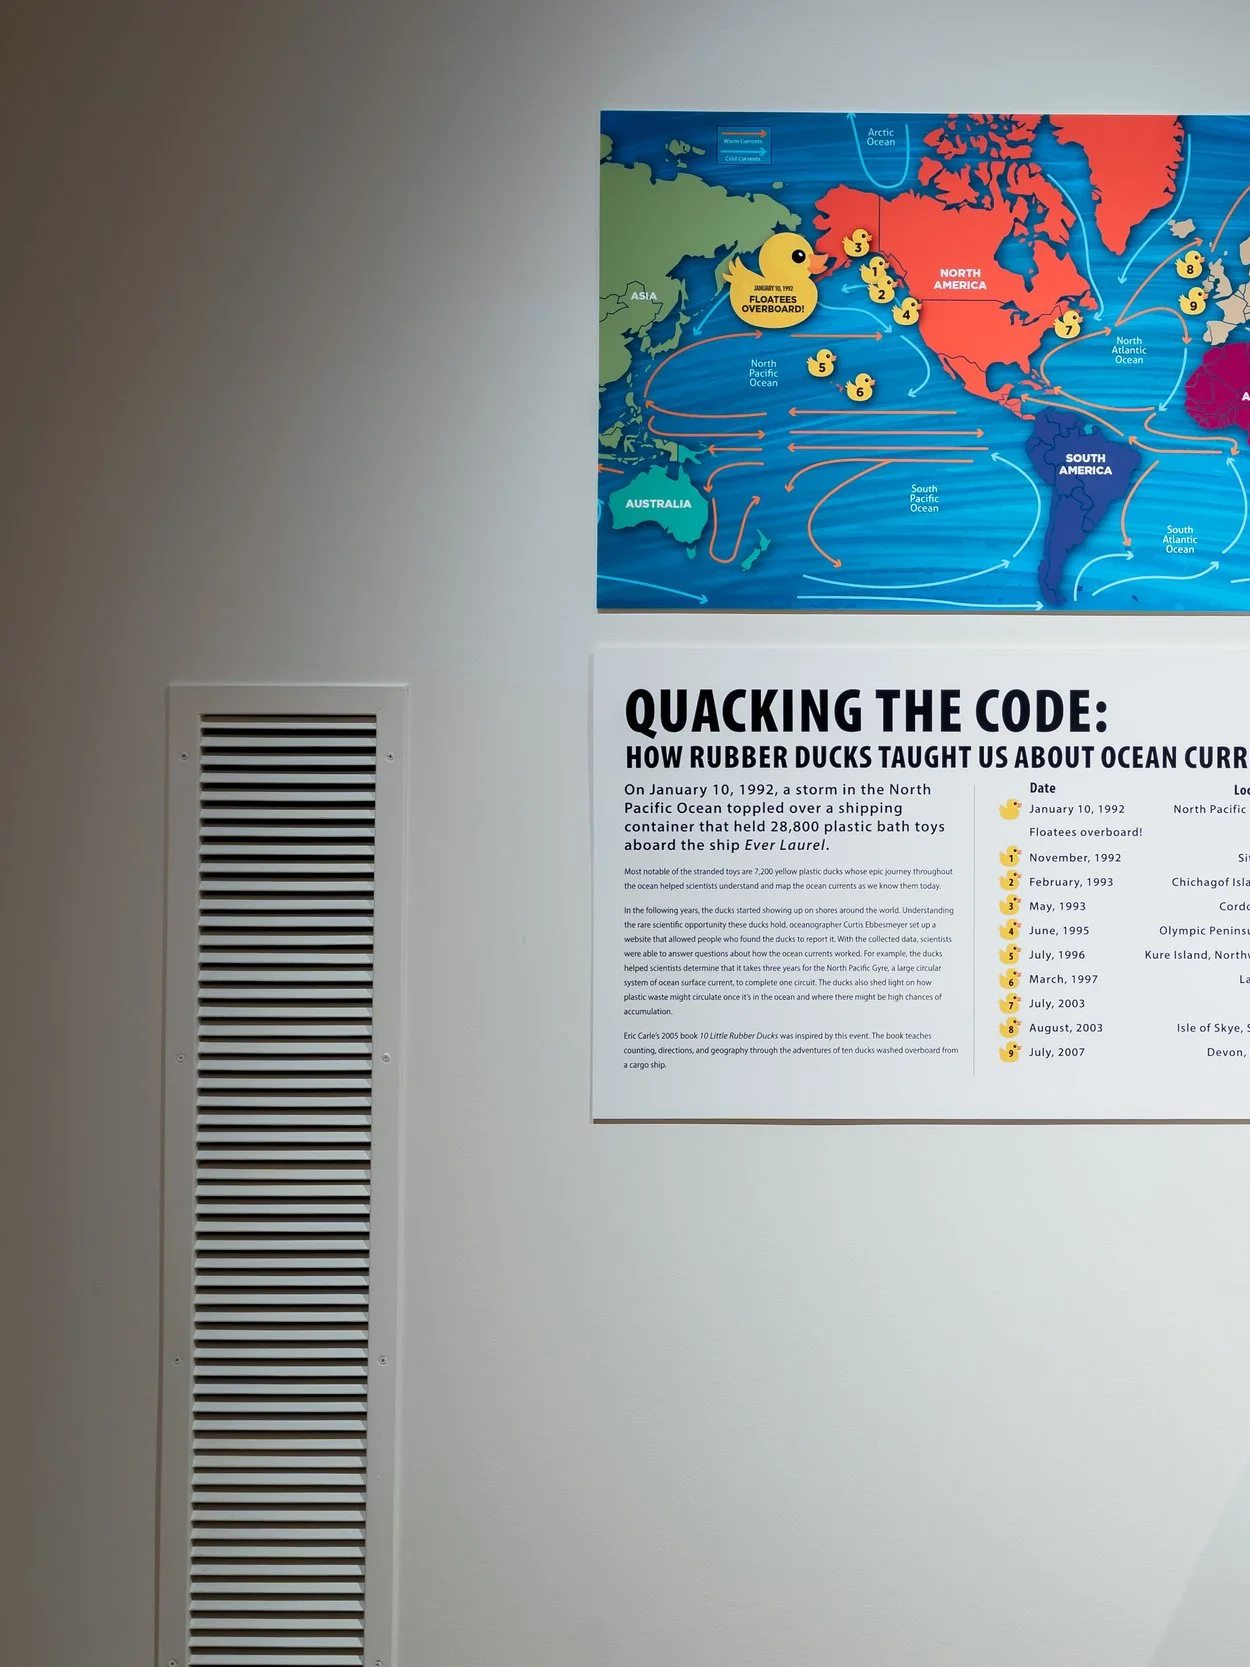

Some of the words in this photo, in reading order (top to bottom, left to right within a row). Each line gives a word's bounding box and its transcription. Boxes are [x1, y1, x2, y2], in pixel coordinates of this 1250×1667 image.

[868, 128, 894, 137] Arctic
[866, 137, 895, 147] Ocean
[854, 243, 862, 253] 3
[872, 266, 877, 277] 1
[940, 268, 981, 278] NORTH
[1186, 264, 1194, 274] 8
[934, 280, 987, 290] AMERICA
[631, 291, 658, 300] ASIA
[749, 295, 797, 304] FLOATEES
[878, 289, 886, 300] 2
[741, 304, 804, 313] OVERBOARD!
[1190, 301, 1198, 311] 9
[902, 310, 911, 320] 4
[1065, 325, 1073, 336] 7
[1116, 336, 1142, 345] North
[1112, 346, 1147, 355] Atlantic
[751, 359, 777, 368] North
[1114, 355, 1144, 364] Ocean
[818, 362, 826, 372] 5
[749, 369, 778, 378] Pacific
[749, 378, 778, 387] Ocean
[856, 387, 864, 397] 6
[1066, 454, 1106, 463] SOUTH
[1059, 466, 1112, 475] AMERICA
[911, 484, 938, 494] South
[626, 499, 692, 508] AUSTRALIA
[910, 494, 938, 503] Pacific
[910, 503, 939, 512] Ocean
[1167, 525, 1194, 534] South
[1162, 535, 1197, 544] Atlantic
[1166, 544, 1194, 554] Ocean
[625, 688, 862, 740] QUACKING
[875, 689, 961, 732] THE
[976, 689, 1107, 733] CODE:
[626, 745, 683, 769] HOW
[690, 745, 788, 768] RUBBER
[795, 745, 872, 768] DUCKS
[878, 745, 972, 768] TAUGHT
[979, 746, 1008, 768] US
[1014, 746, 1094, 768] ABOUT
[1101, 746, 1177, 768] OCEAN
[624, 783, 644, 796] On
[649, 784, 708, 798] January
[713, 784, 734, 797] 10,
[740, 784, 778, 797] 1992,
[783, 786, 790, 795] a
[796, 785, 837, 795] storm
[843, 783, 856, 795] in
[860, 783, 884, 795] the
[890, 783, 931, 795] North
[1030, 782, 1056, 794] Date
[625, 801, 672, 814] Pacific
[677, 802, 722, 814] Ocean
[727, 802, 784, 817] toppled
[789, 805, 821, 814] over
[826, 805, 833, 814] a
[839, 802, 902, 817] shipping
[1029, 804, 1074, 816] January
[1078, 804, 1094, 814] 10,
[1098, 804, 1125, 814] 1992
[1174, 804, 1206, 814] North
[1210, 804, 1246, 814] Pacific
[624, 820, 695, 832] container
[699, 820, 729, 832] that
[734, 820, 765, 832] held
[770, 821, 819, 834] 28,800
[824, 820, 872, 835] plastic
[877, 820, 910, 832] bath
[915, 822, 945, 835] toys
[1029, 827, 1077, 837] Floatees
[1080, 827, 1142, 837] overboard!
[624, 838, 676, 851] aboard
[680, 838, 705, 851] the
[710, 838, 740, 854] ship
[745, 839, 776, 851] Ever
[780, 838, 829, 851] Laurel.
[1009, 854, 1013, 862] 1
[1030, 853, 1090, 863] November,
[1095, 853, 1121, 862] 1992
[624, 868, 642, 876] Most
[643, 867, 670, 876] notable
[671, 867, 680, 875] of
[680, 868, 692, 876] the
[693, 867, 724, 875] stranded
[725, 868, 741, 877] toys
[754, 868, 774, 876] 7,200
[774, 868, 798, 877] yellow
[799, 868, 821, 876] plastic
[913, 868, 953, 876] throughout
[1008, 928, 1014, 936] 4
[1029, 926, 1058, 936] June,
[1063, 926, 1089, 935] 1995
[1159, 926, 1206, 938] Olympic
[1008, 978, 1014, 987] 6
[1029, 974, 1067, 984] March,
[1072, 974, 1098, 984] 1997
[1008, 1049, 1014, 1058] 9
[1029, 1047, 1054, 1059] July,
[1058, 1047, 1085, 1057] 2007
[1207, 1047, 1246, 1058] Devon,
